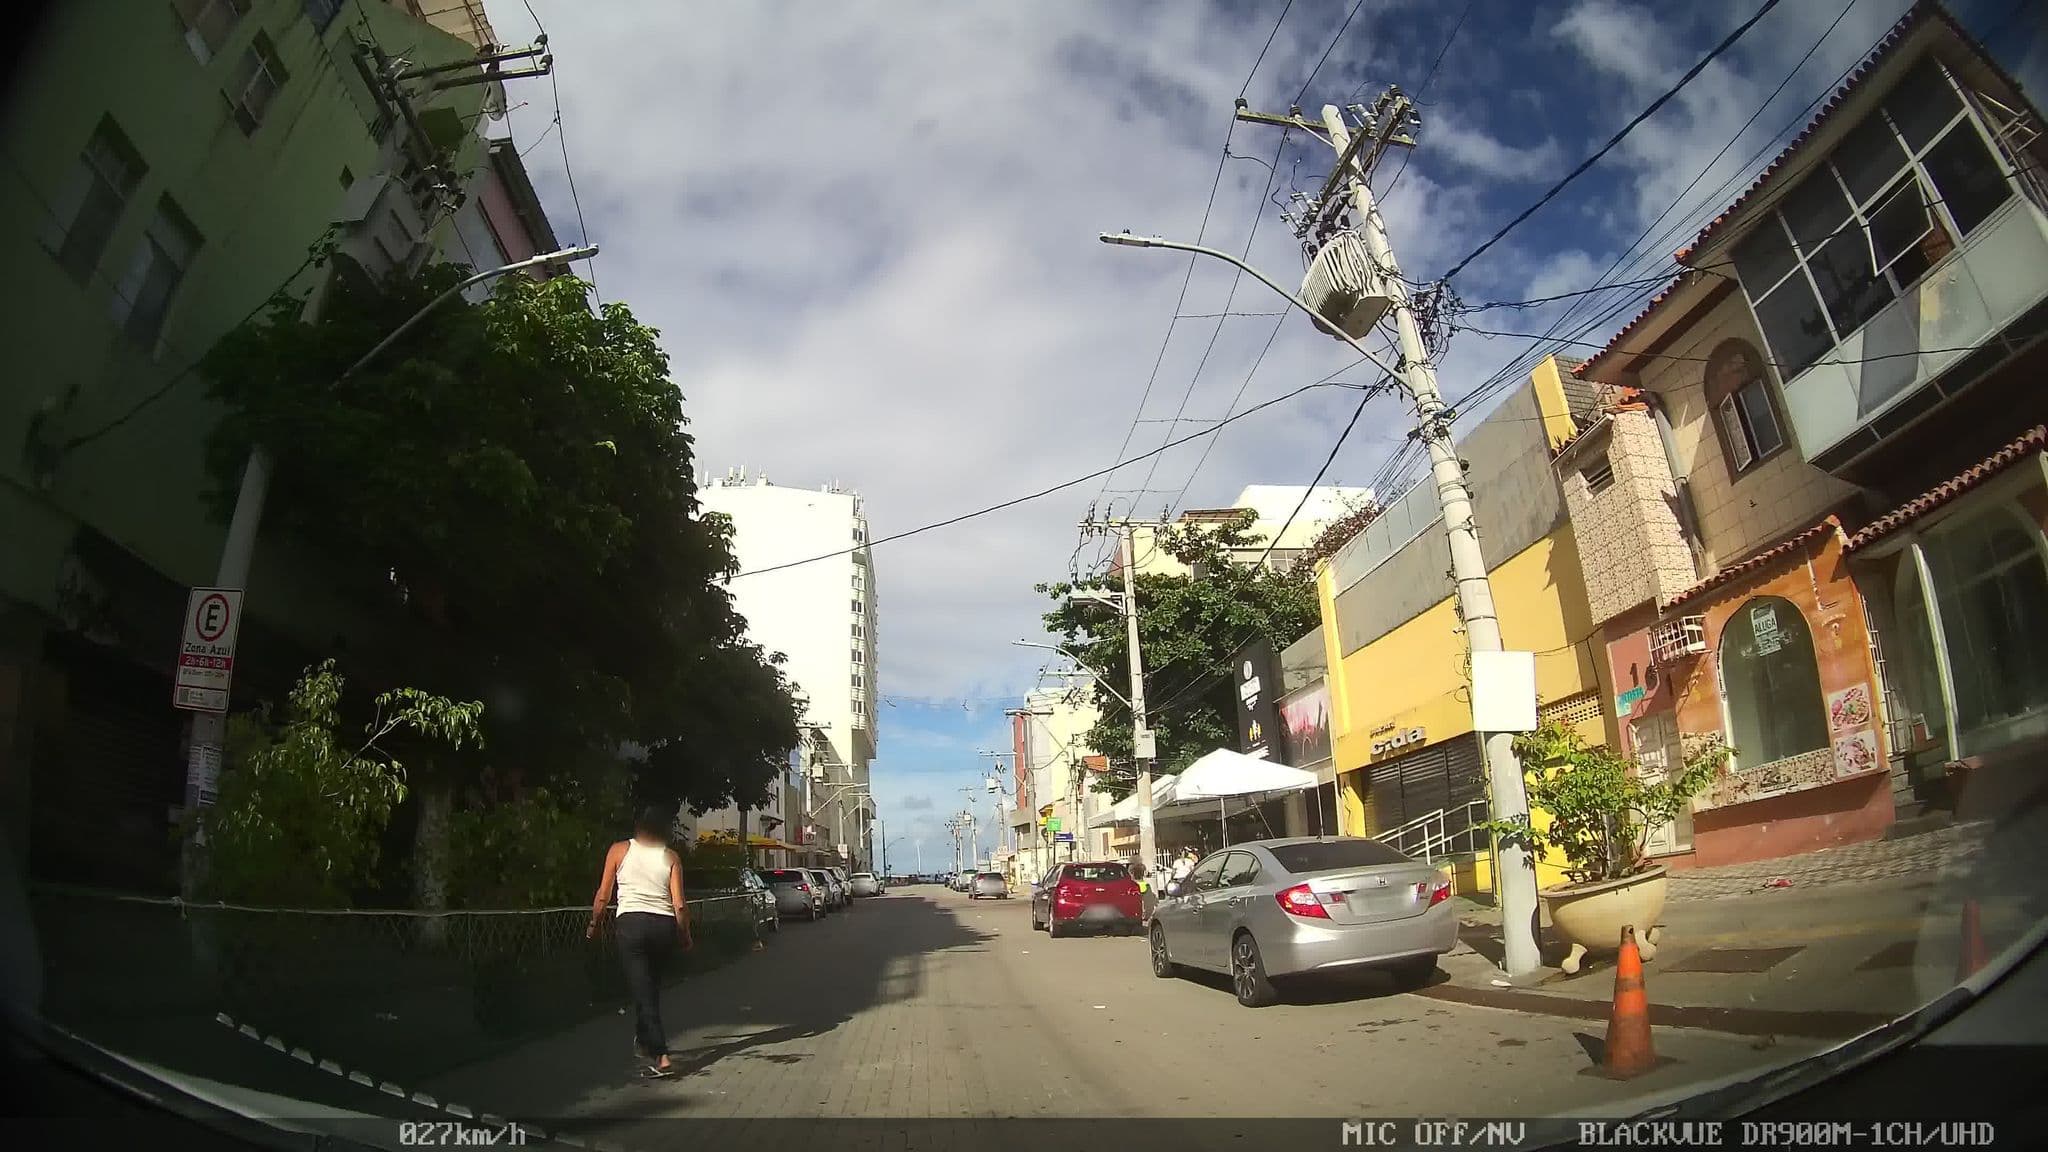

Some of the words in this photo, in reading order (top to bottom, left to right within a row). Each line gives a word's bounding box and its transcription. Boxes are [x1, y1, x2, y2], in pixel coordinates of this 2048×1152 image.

[204, 603, 220, 631] E
[1755, 617, 1776, 633] ALUGA
[185, 642, 206, 654] Zona
[210, 645, 231, 656] Azul
